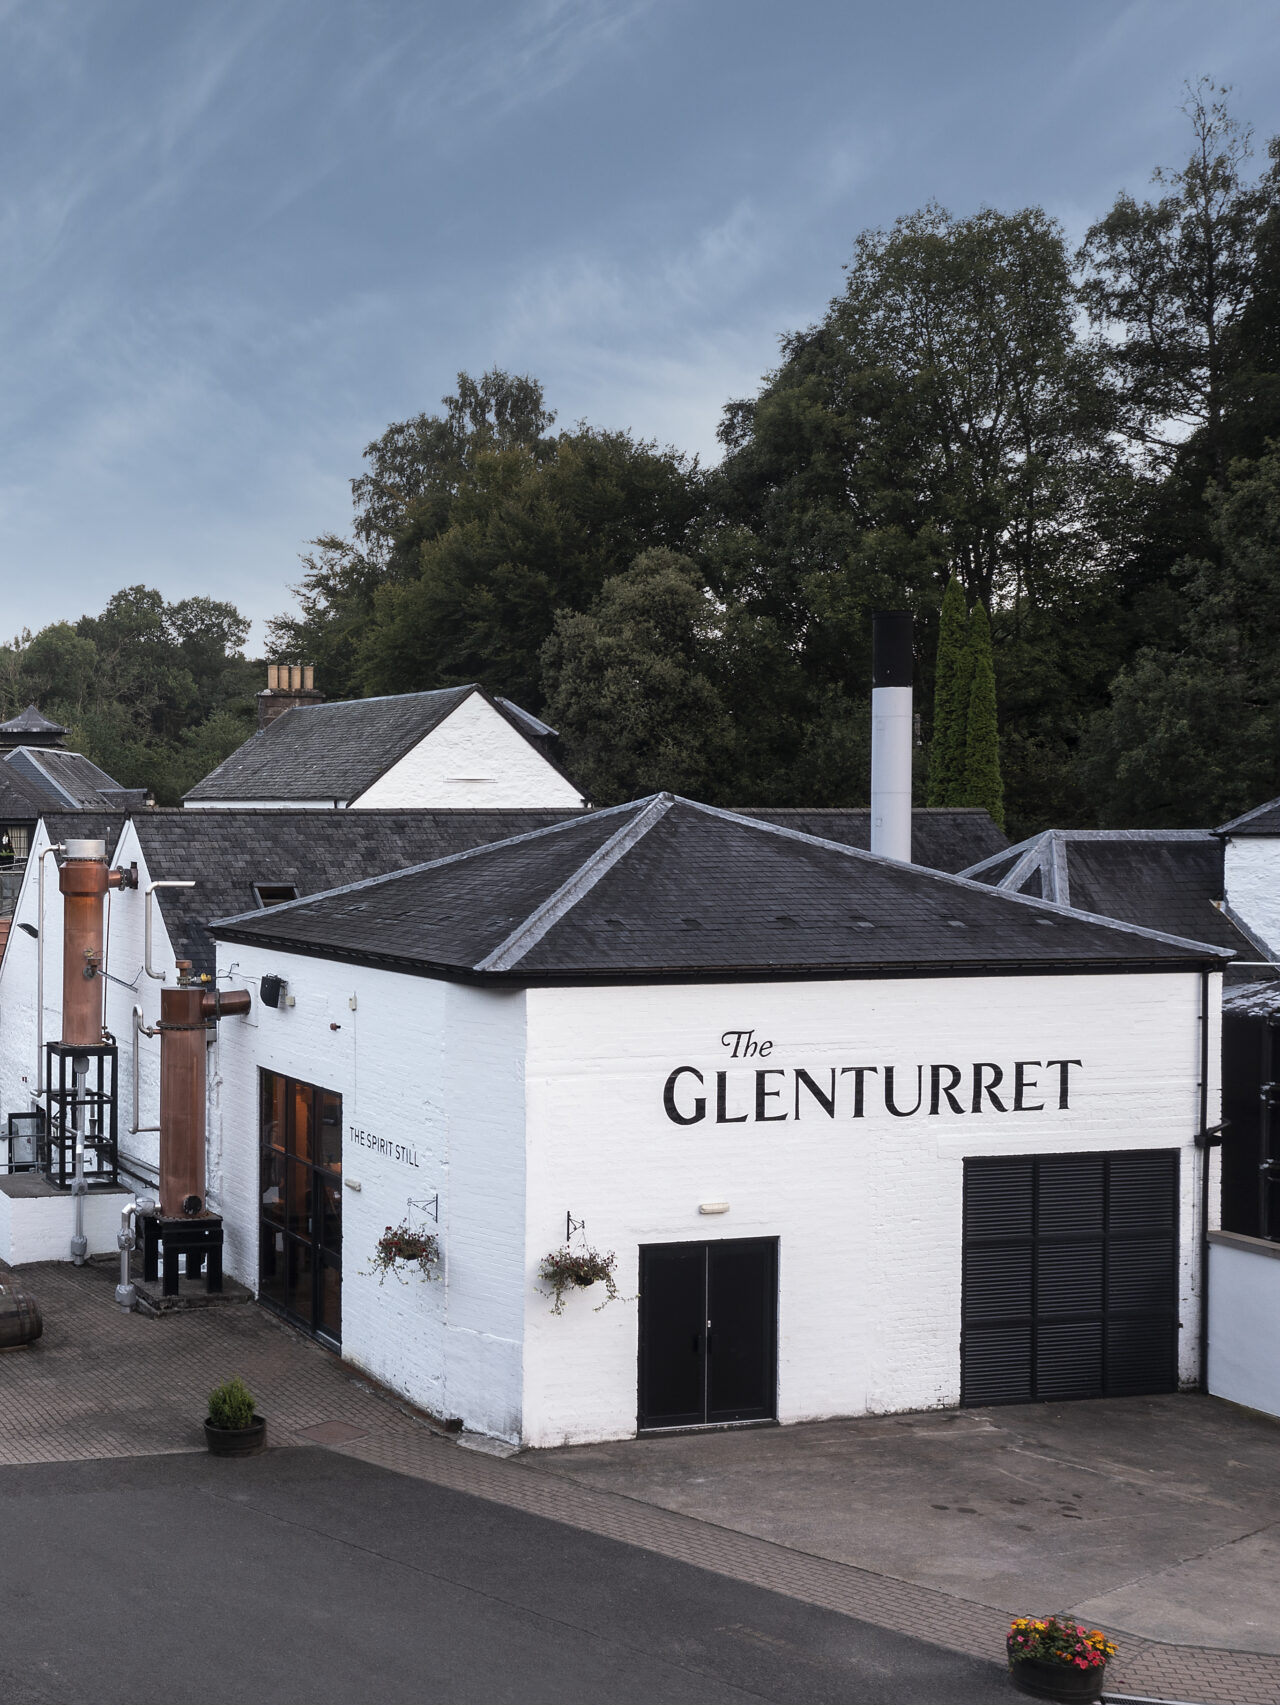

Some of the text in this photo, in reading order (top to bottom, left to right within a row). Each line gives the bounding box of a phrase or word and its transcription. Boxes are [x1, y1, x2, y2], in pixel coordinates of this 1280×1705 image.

[721, 1029, 773, 1059] The
[663, 1059, 1084, 1126] GLENTURRET
[349, 1126, 419, 1168] THE SPIRIT STILL
